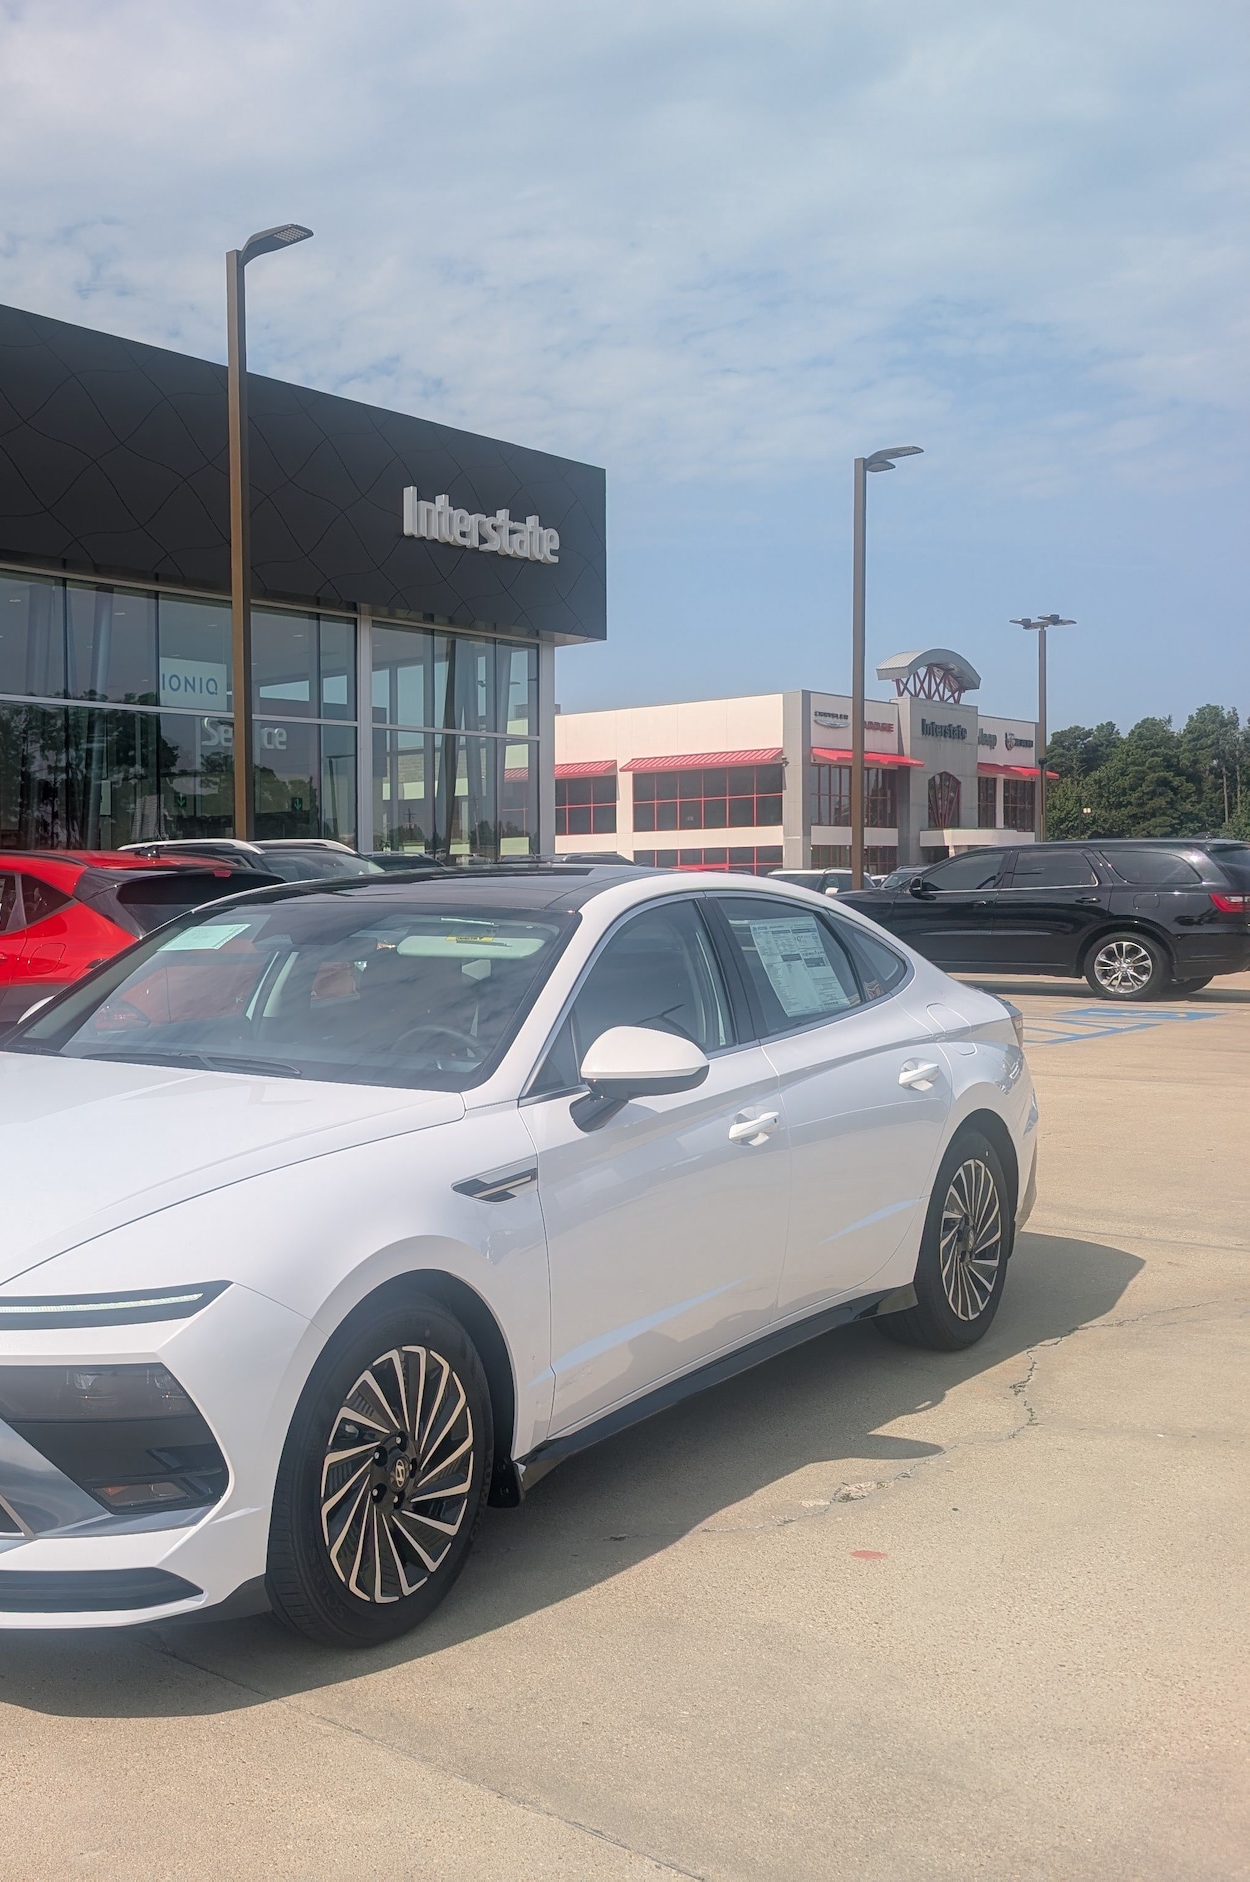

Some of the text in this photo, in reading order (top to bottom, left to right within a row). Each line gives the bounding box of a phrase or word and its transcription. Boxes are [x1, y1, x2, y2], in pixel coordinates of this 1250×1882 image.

[403, 485, 560, 564] Interstate
[161, 673, 218, 695] IONIQ
[921, 718, 967, 740] Interstate
[977, 728, 997, 750] Jeep
